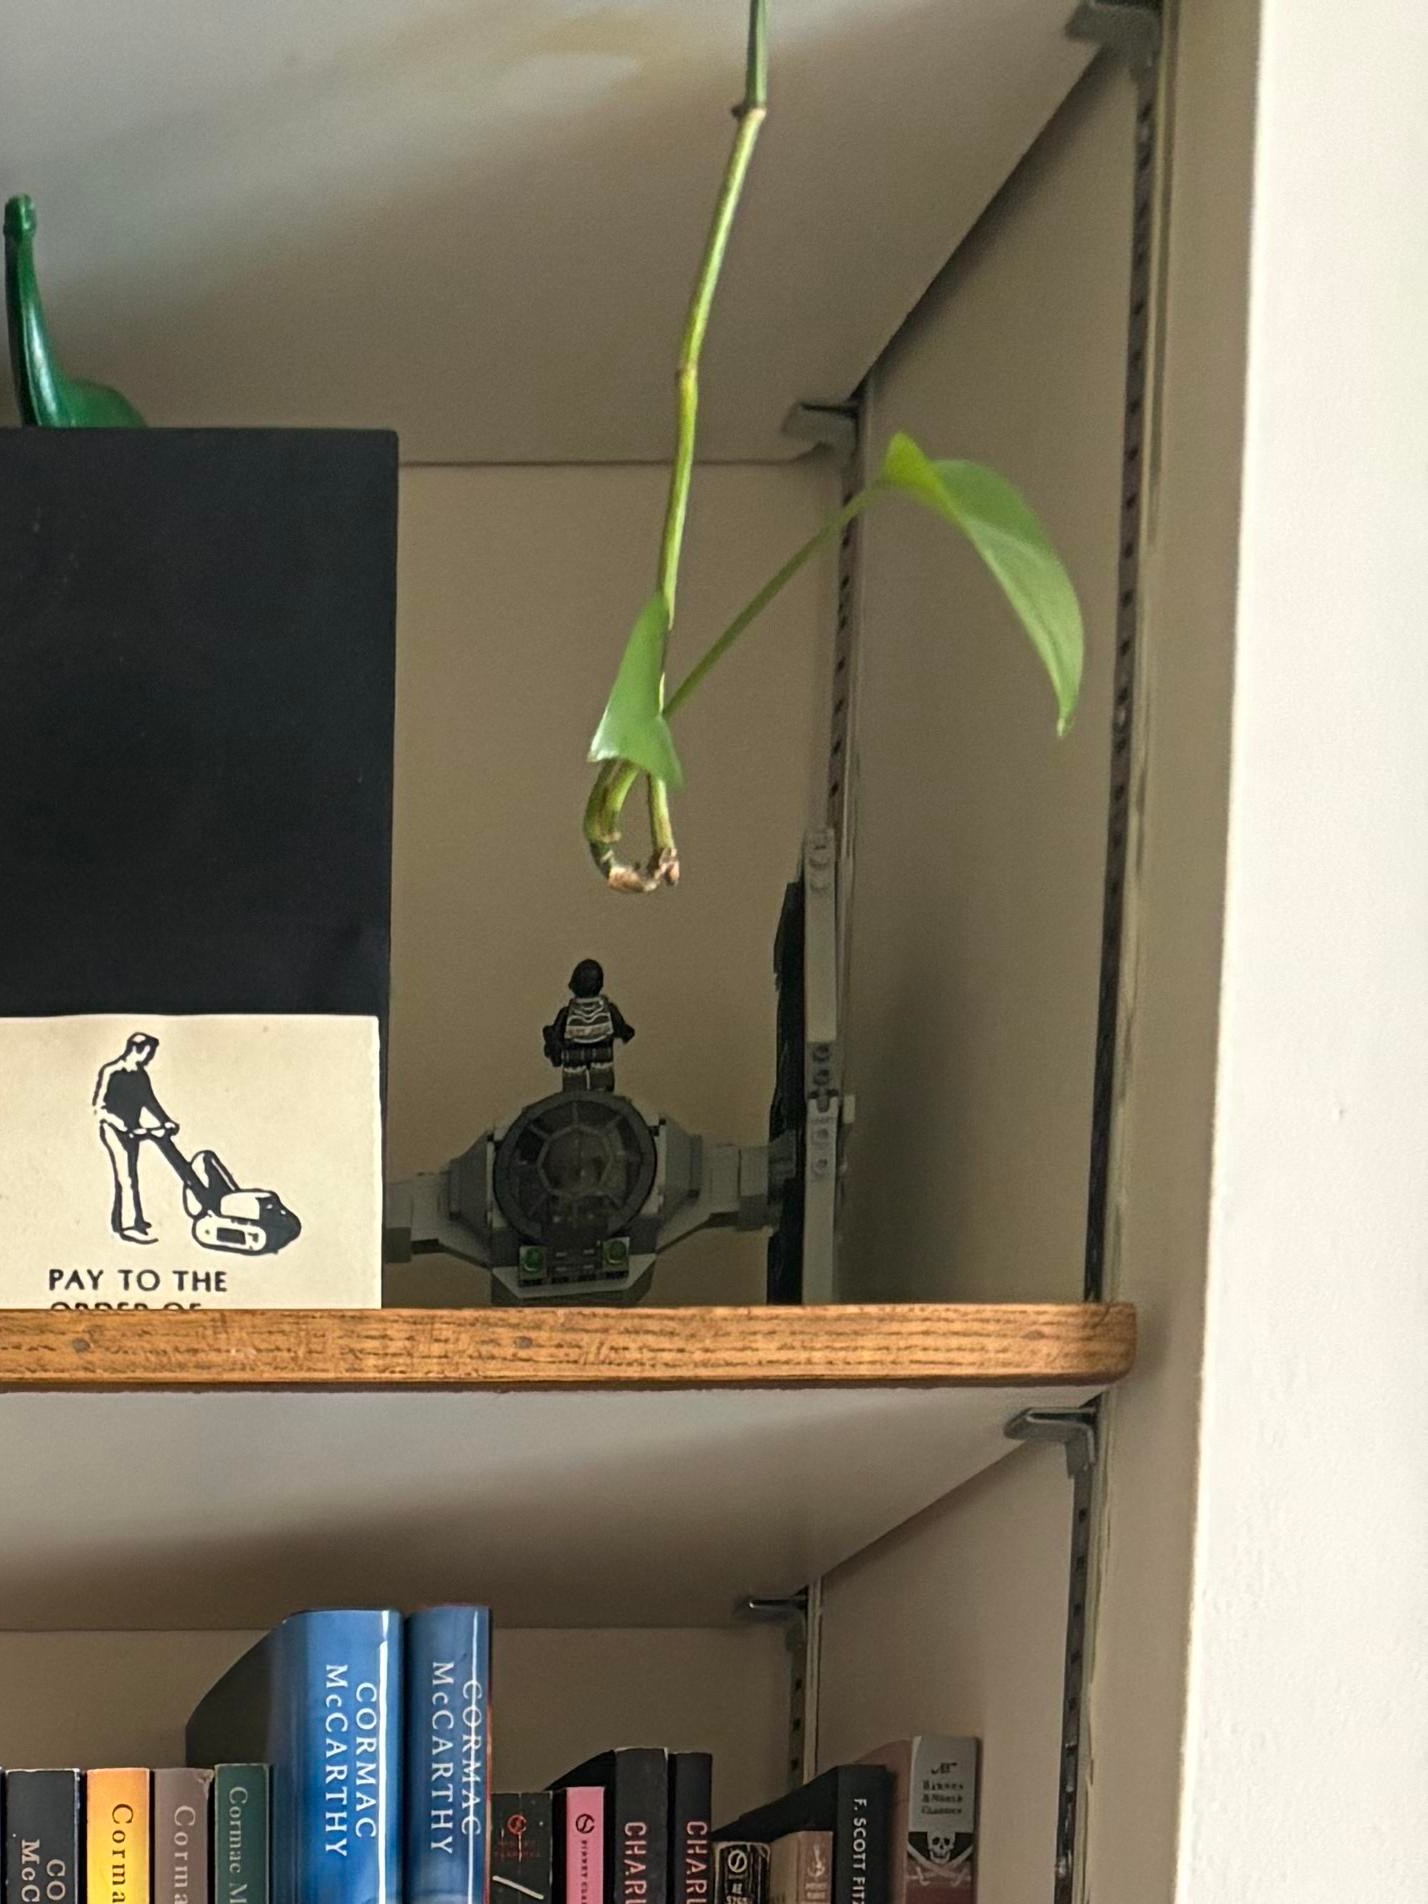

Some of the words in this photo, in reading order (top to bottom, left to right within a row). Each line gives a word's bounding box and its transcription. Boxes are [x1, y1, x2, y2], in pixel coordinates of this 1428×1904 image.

[48, 1269, 104, 1294] PAY
[115, 1269, 161, 1293] TO
[170, 1269, 228, 1293] THE
